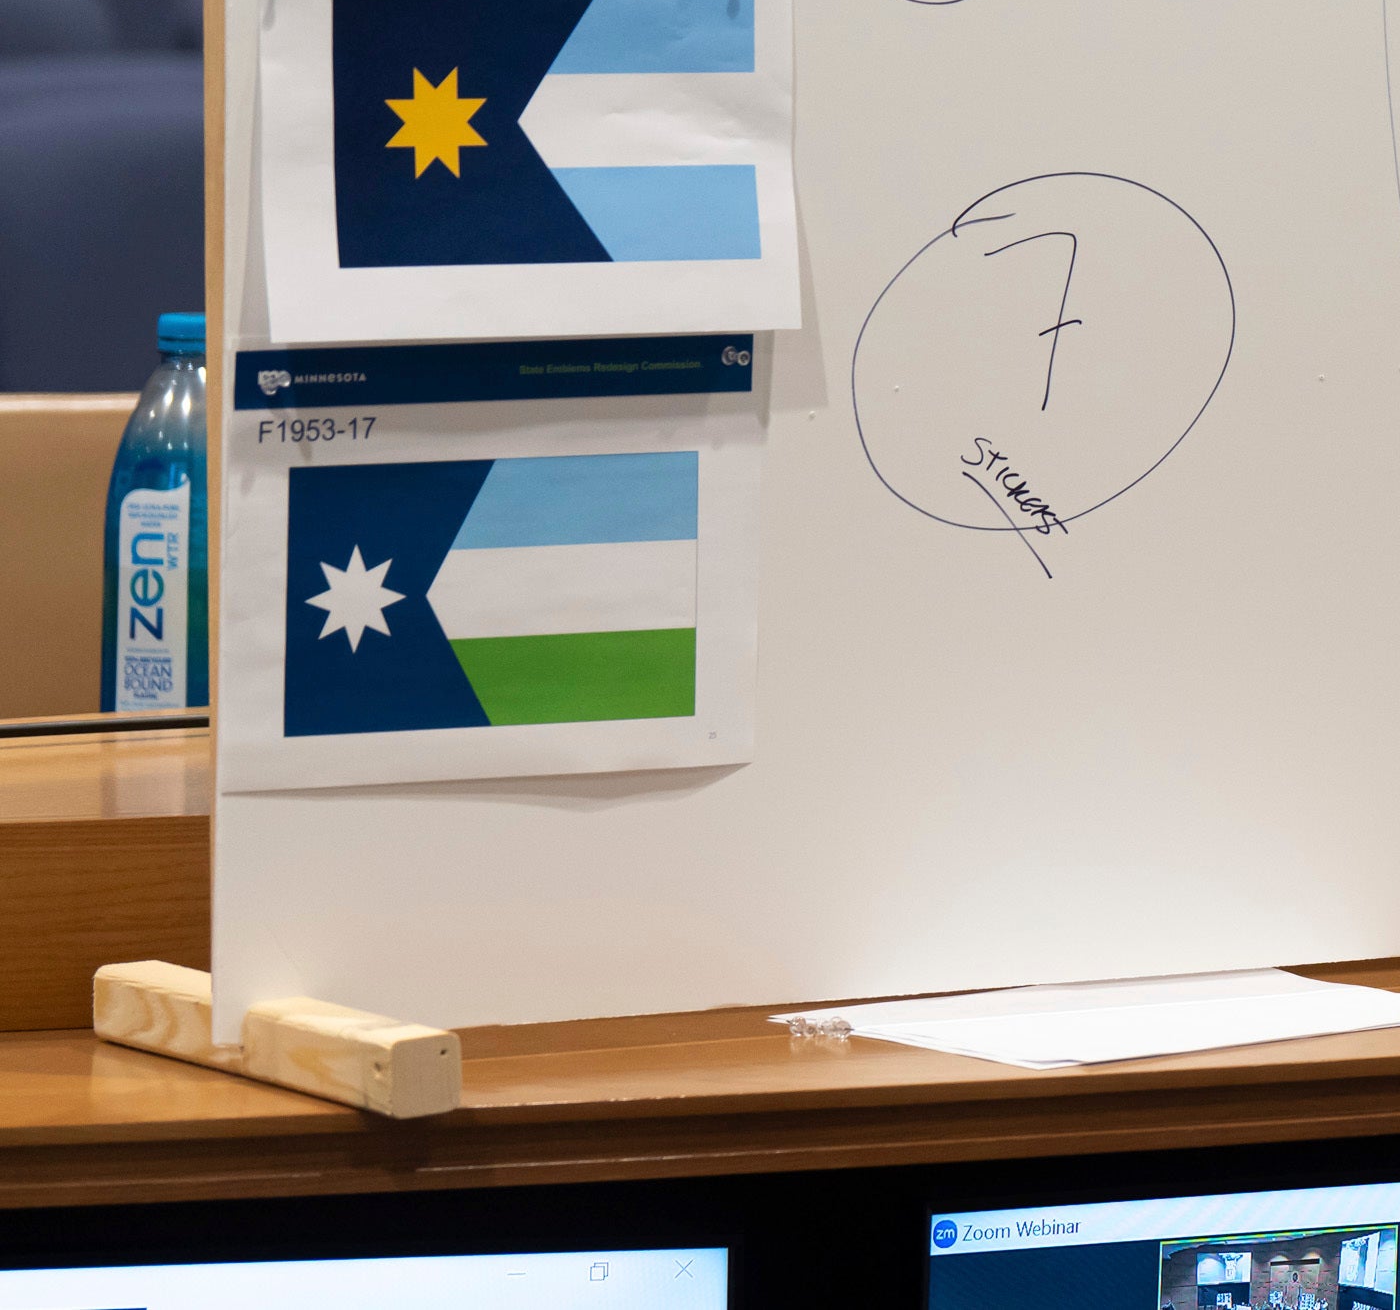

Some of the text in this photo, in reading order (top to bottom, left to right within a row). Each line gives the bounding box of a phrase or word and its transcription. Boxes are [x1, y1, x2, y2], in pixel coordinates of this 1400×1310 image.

[984, 231, 1082, 411] 7
[520, 365, 545, 375] State
[547, 364, 591, 374] Emblems
[594, 361, 639, 373] Redesign
[258, 417, 377, 444] F1953-17
[130, 532, 165, 640] zen
[124, 663, 172, 677] OCEAN
[124, 676, 173, 693] BOUND
[962, 1219, 1082, 1242] Zoom Webinar
